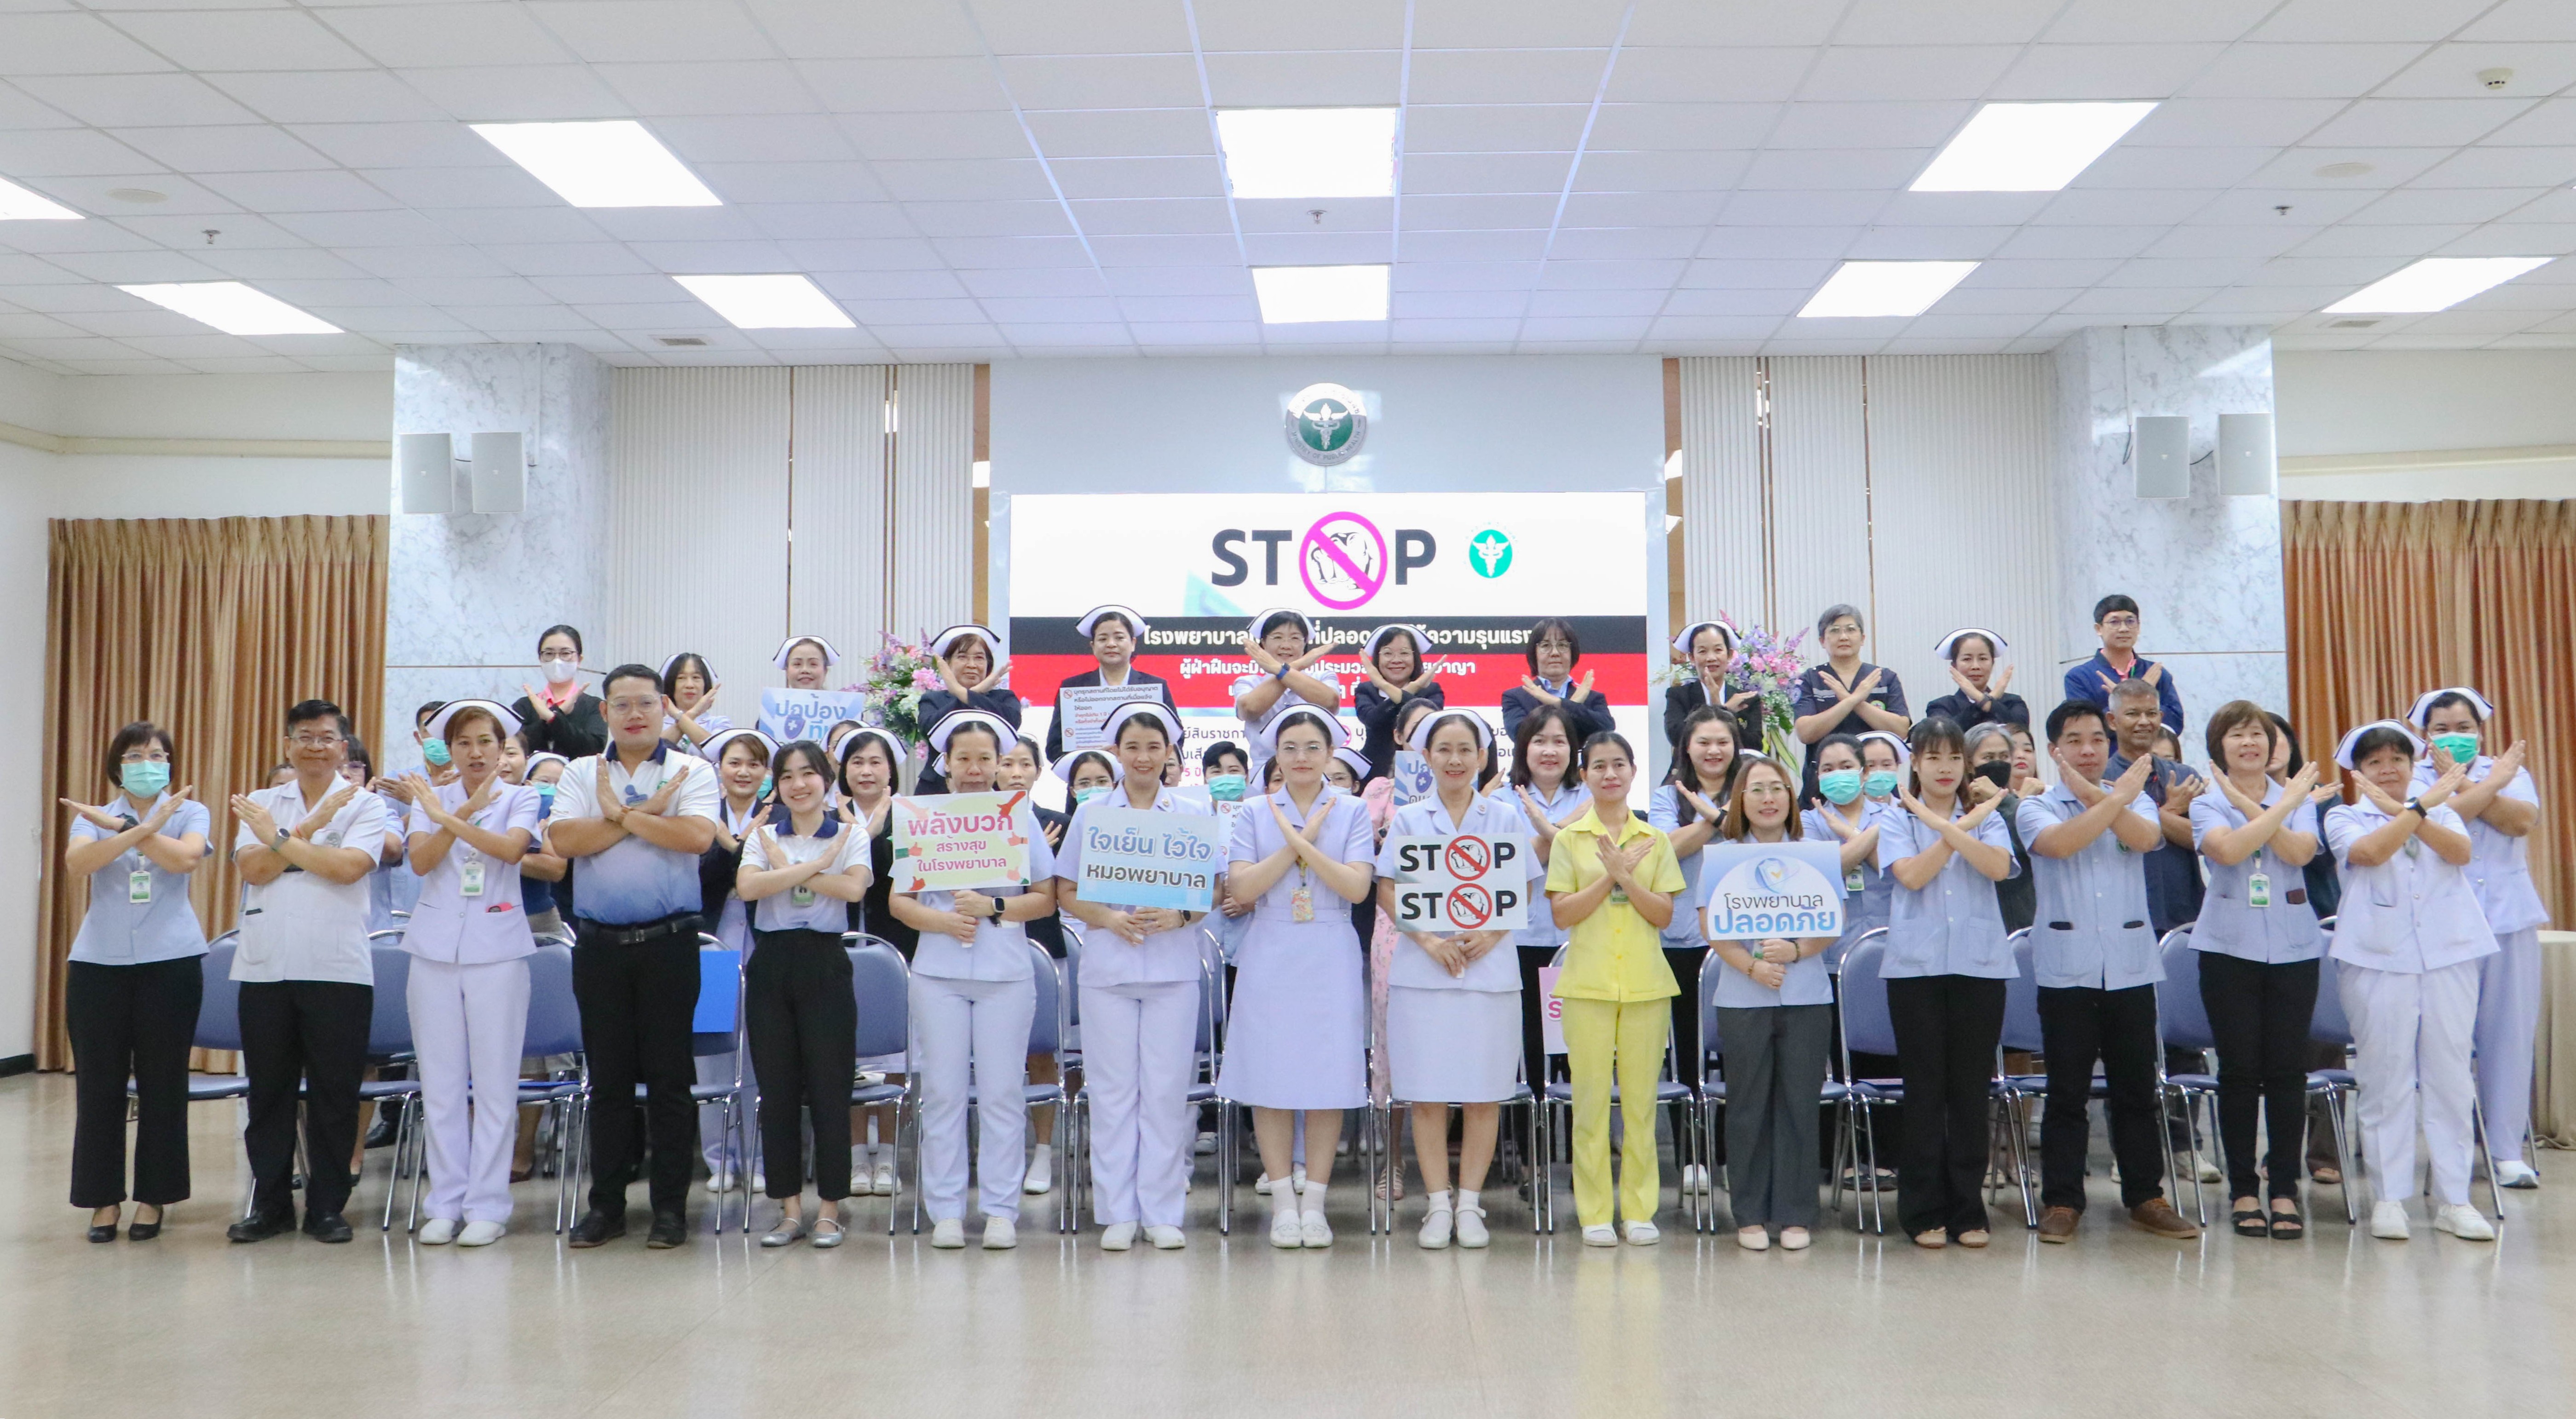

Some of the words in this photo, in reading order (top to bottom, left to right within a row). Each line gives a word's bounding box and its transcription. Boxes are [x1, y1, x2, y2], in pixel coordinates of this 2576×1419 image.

[775, 693, 847, 720] ปกป้อง
[908, 811, 1013, 836] พลังบวก
[937, 835, 986, 854] สร้างสุข
[1089, 826, 1154, 854] ใจเย็น
[1163, 827, 1211, 859] ไว้ใจ
[917, 858, 1007, 872] ในโรงพยาบาล
[1087, 864, 1206, 888] หมอพยาบาล
[1724, 893, 1823, 909] โรงพยาบาล
[1714, 904, 1836, 934] ปลอดภัย
